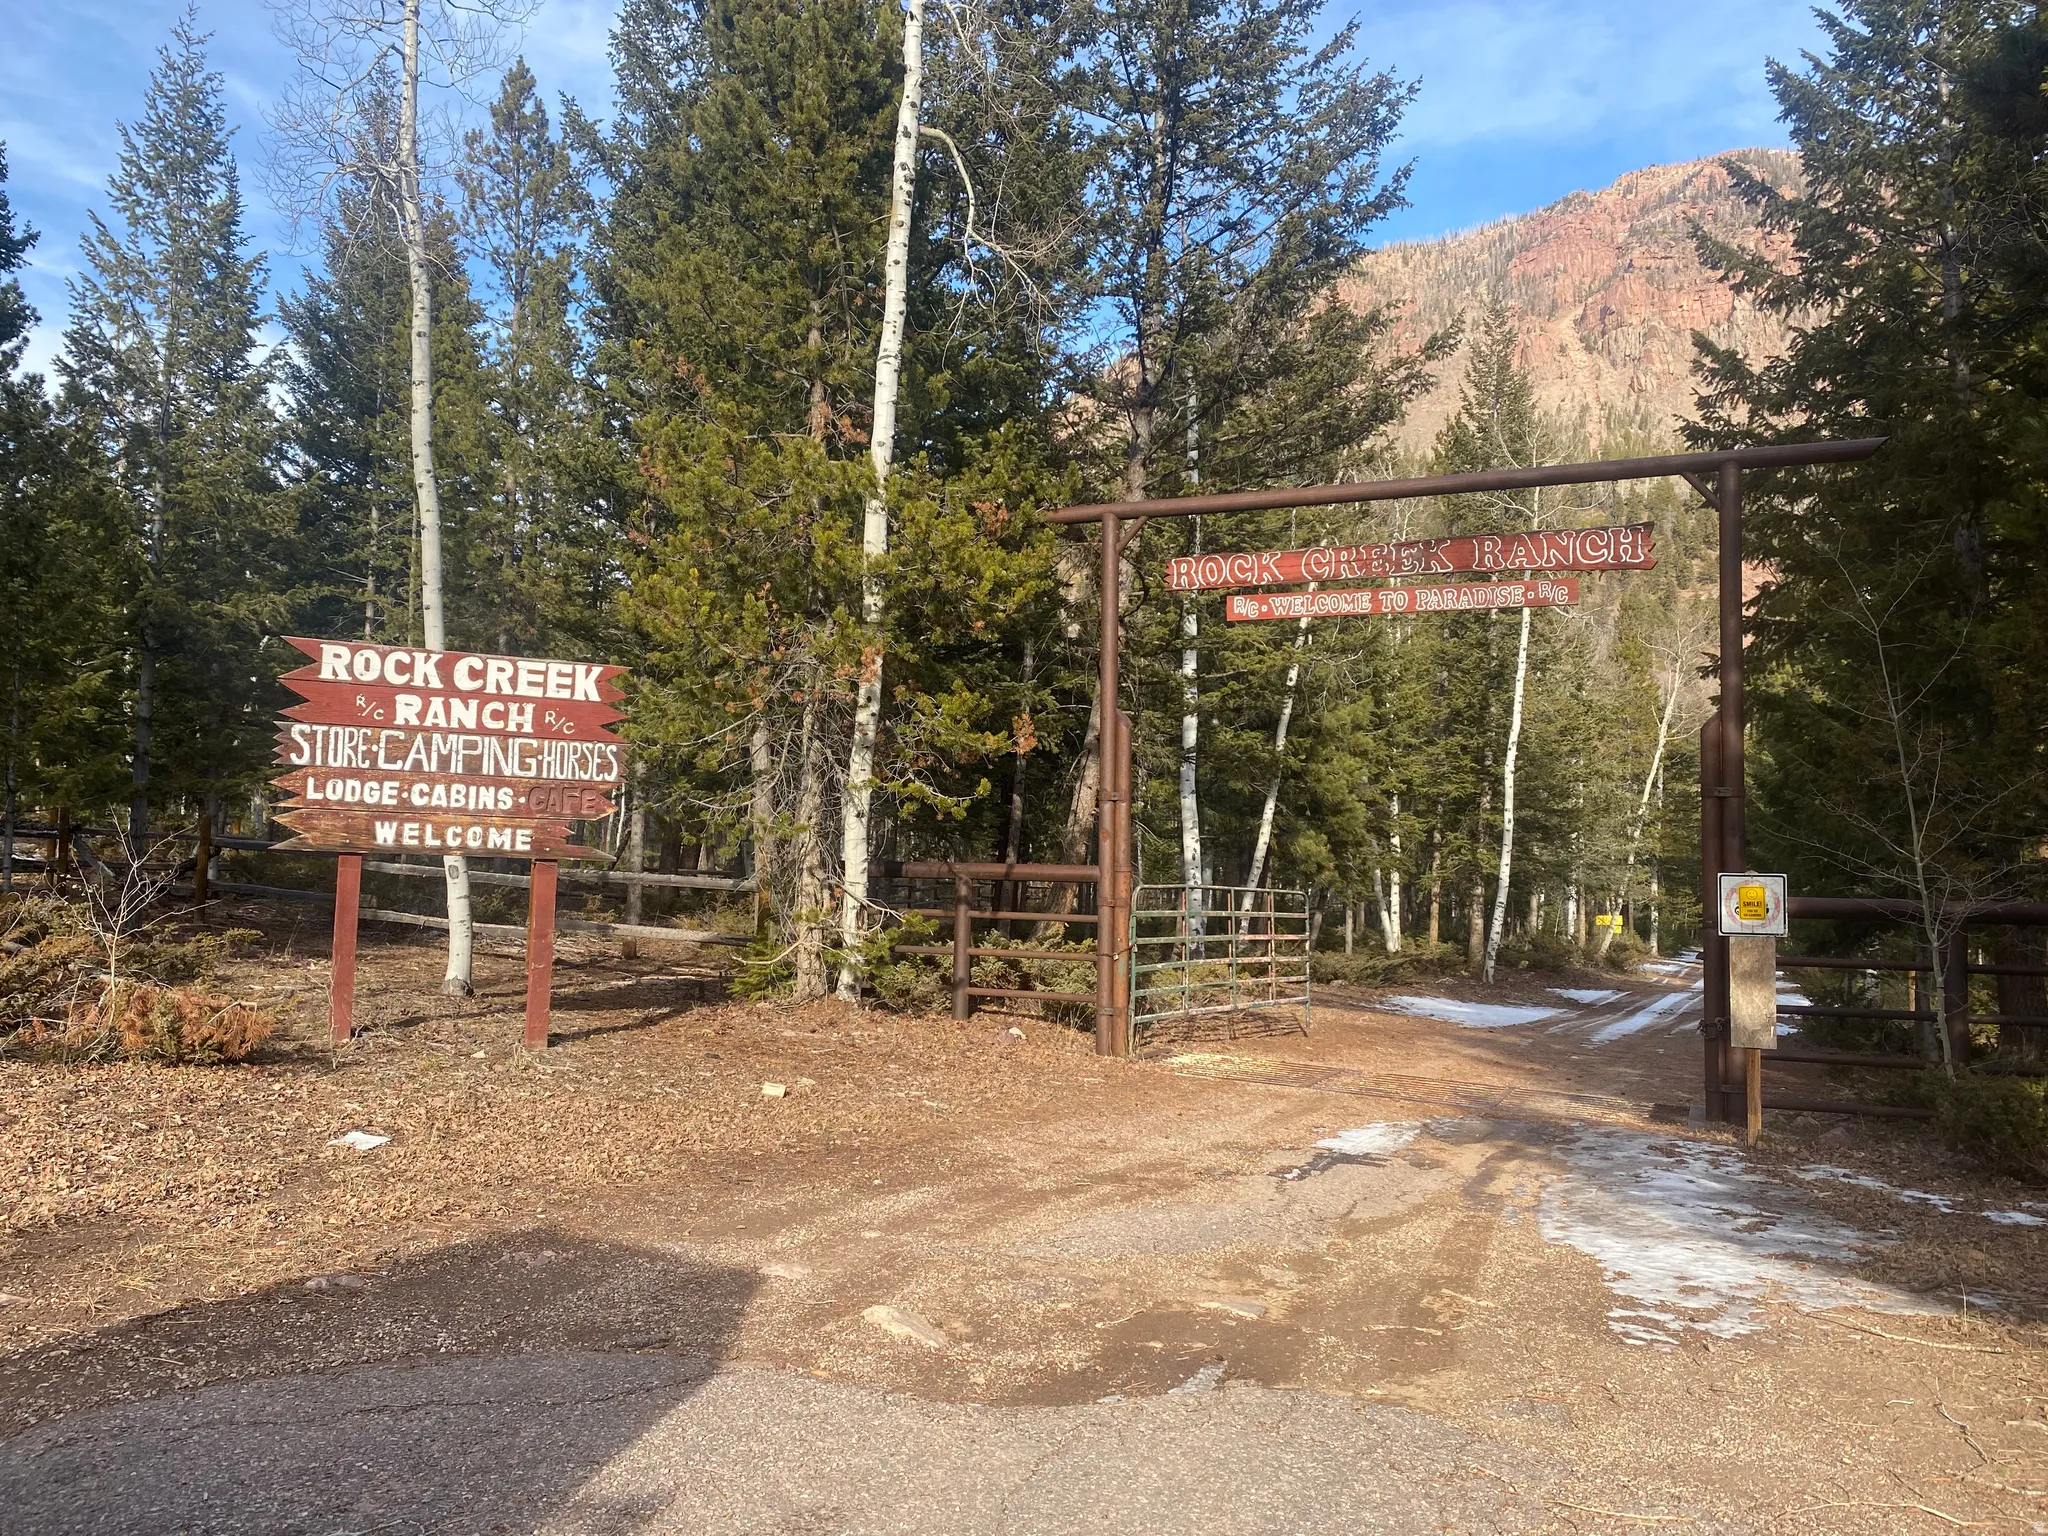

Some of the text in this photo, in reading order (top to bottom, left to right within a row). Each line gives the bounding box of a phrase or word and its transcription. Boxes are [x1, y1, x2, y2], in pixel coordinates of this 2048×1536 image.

[1171, 526, 1645, 590] ROCK CREEK RANCH
[1269, 592, 1372, 616] WELCOME
[1379, 591, 1408, 612] TO
[1416, 585, 1526, 611] PARADISE
[318, 643, 604, 702] ROCK CREEK
[393, 693, 536, 734] RANCH
[527, 786, 598, 814] CAFE
[374, 820, 533, 851] WELCOME
